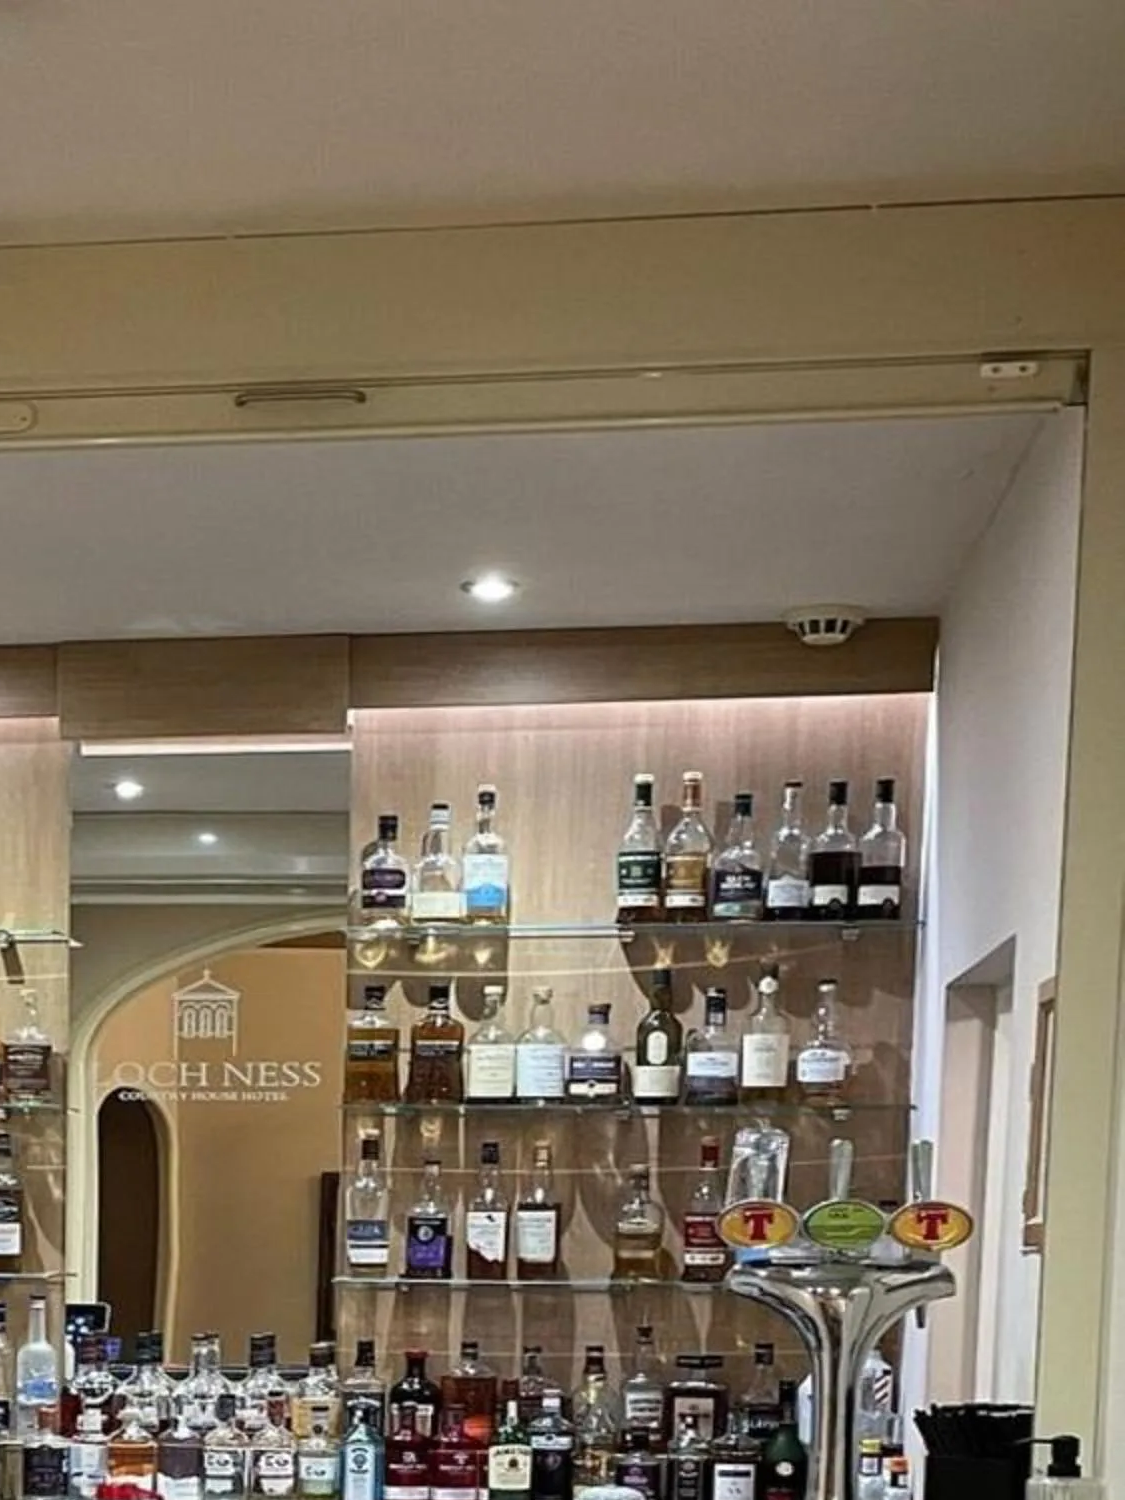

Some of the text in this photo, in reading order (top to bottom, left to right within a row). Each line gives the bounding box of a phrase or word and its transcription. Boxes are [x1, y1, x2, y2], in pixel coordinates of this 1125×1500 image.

[223, 1061, 322, 1087] NESS
[742, 1207, 774, 1241] T
[916, 1208, 949, 1241] T
